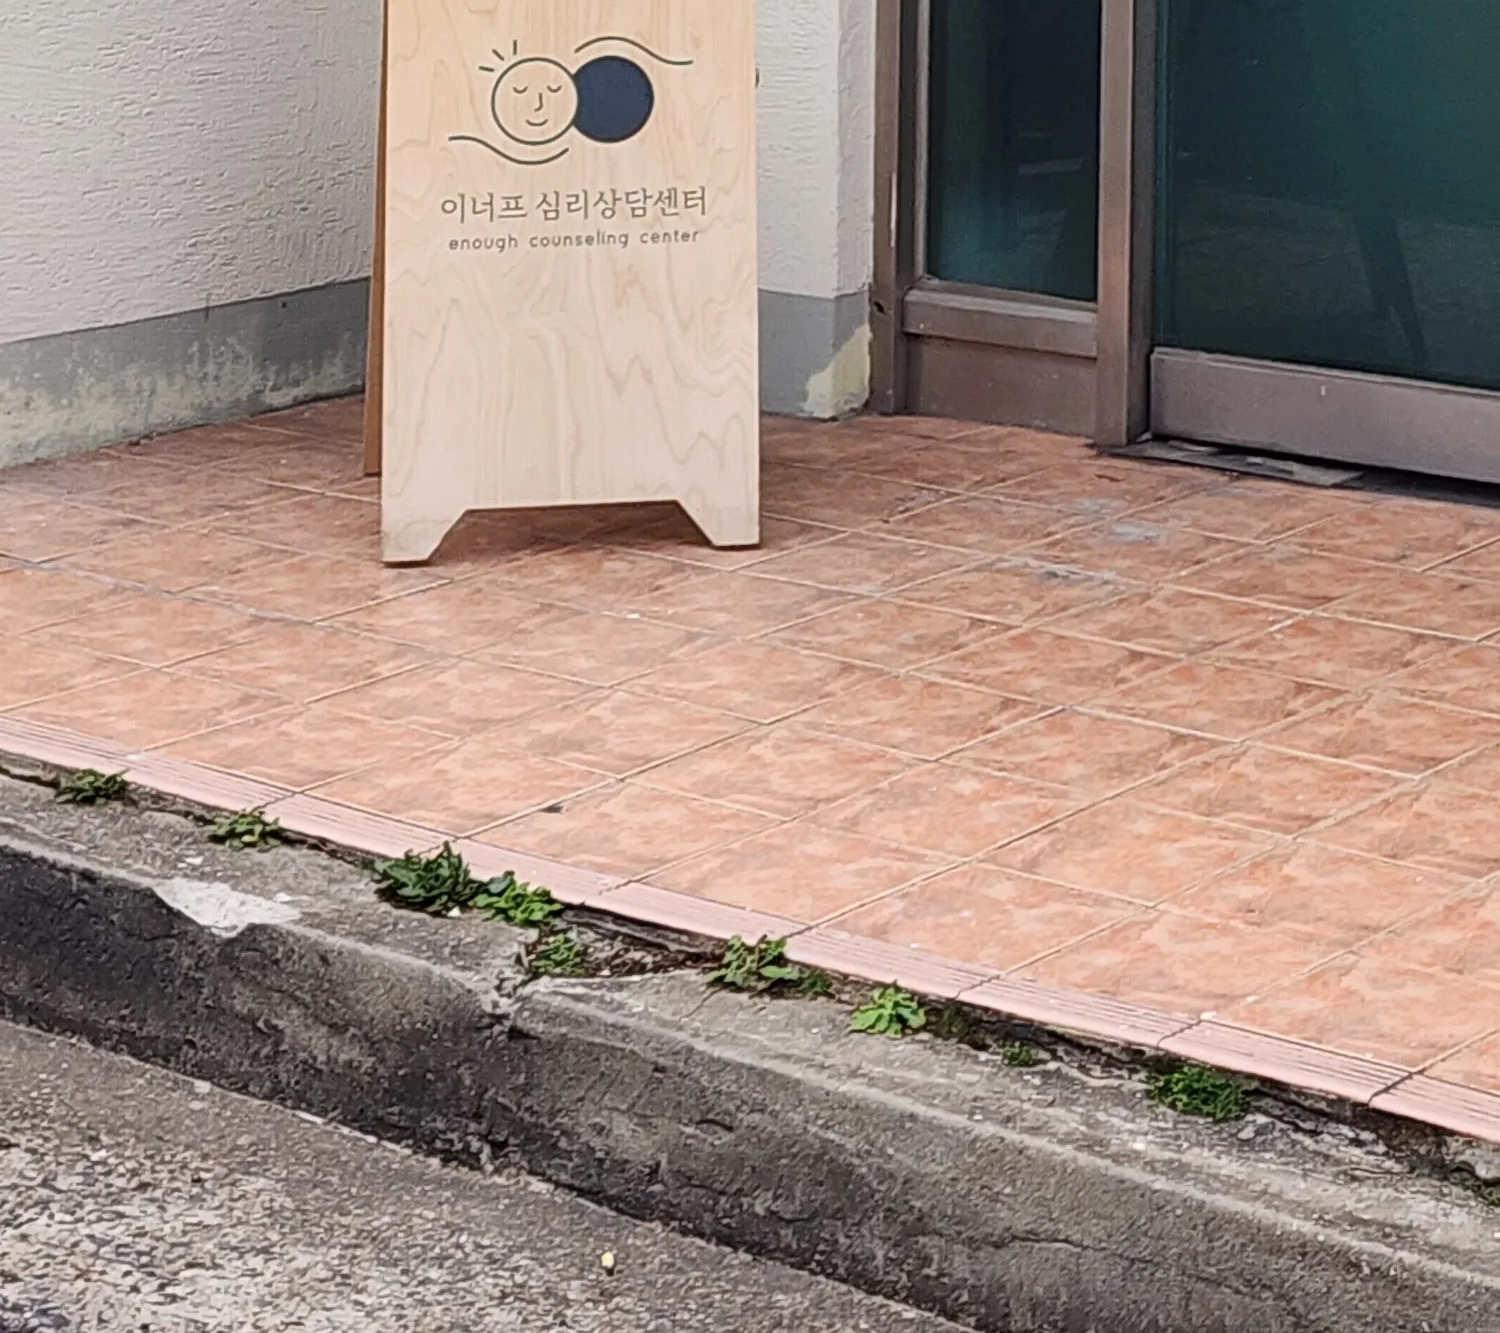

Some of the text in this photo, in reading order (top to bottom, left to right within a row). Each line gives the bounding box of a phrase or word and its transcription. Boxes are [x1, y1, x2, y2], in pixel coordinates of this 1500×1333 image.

[440, 185, 707, 224] 이너프 심리상담센터
[448, 228, 701, 254] enough counseling center
